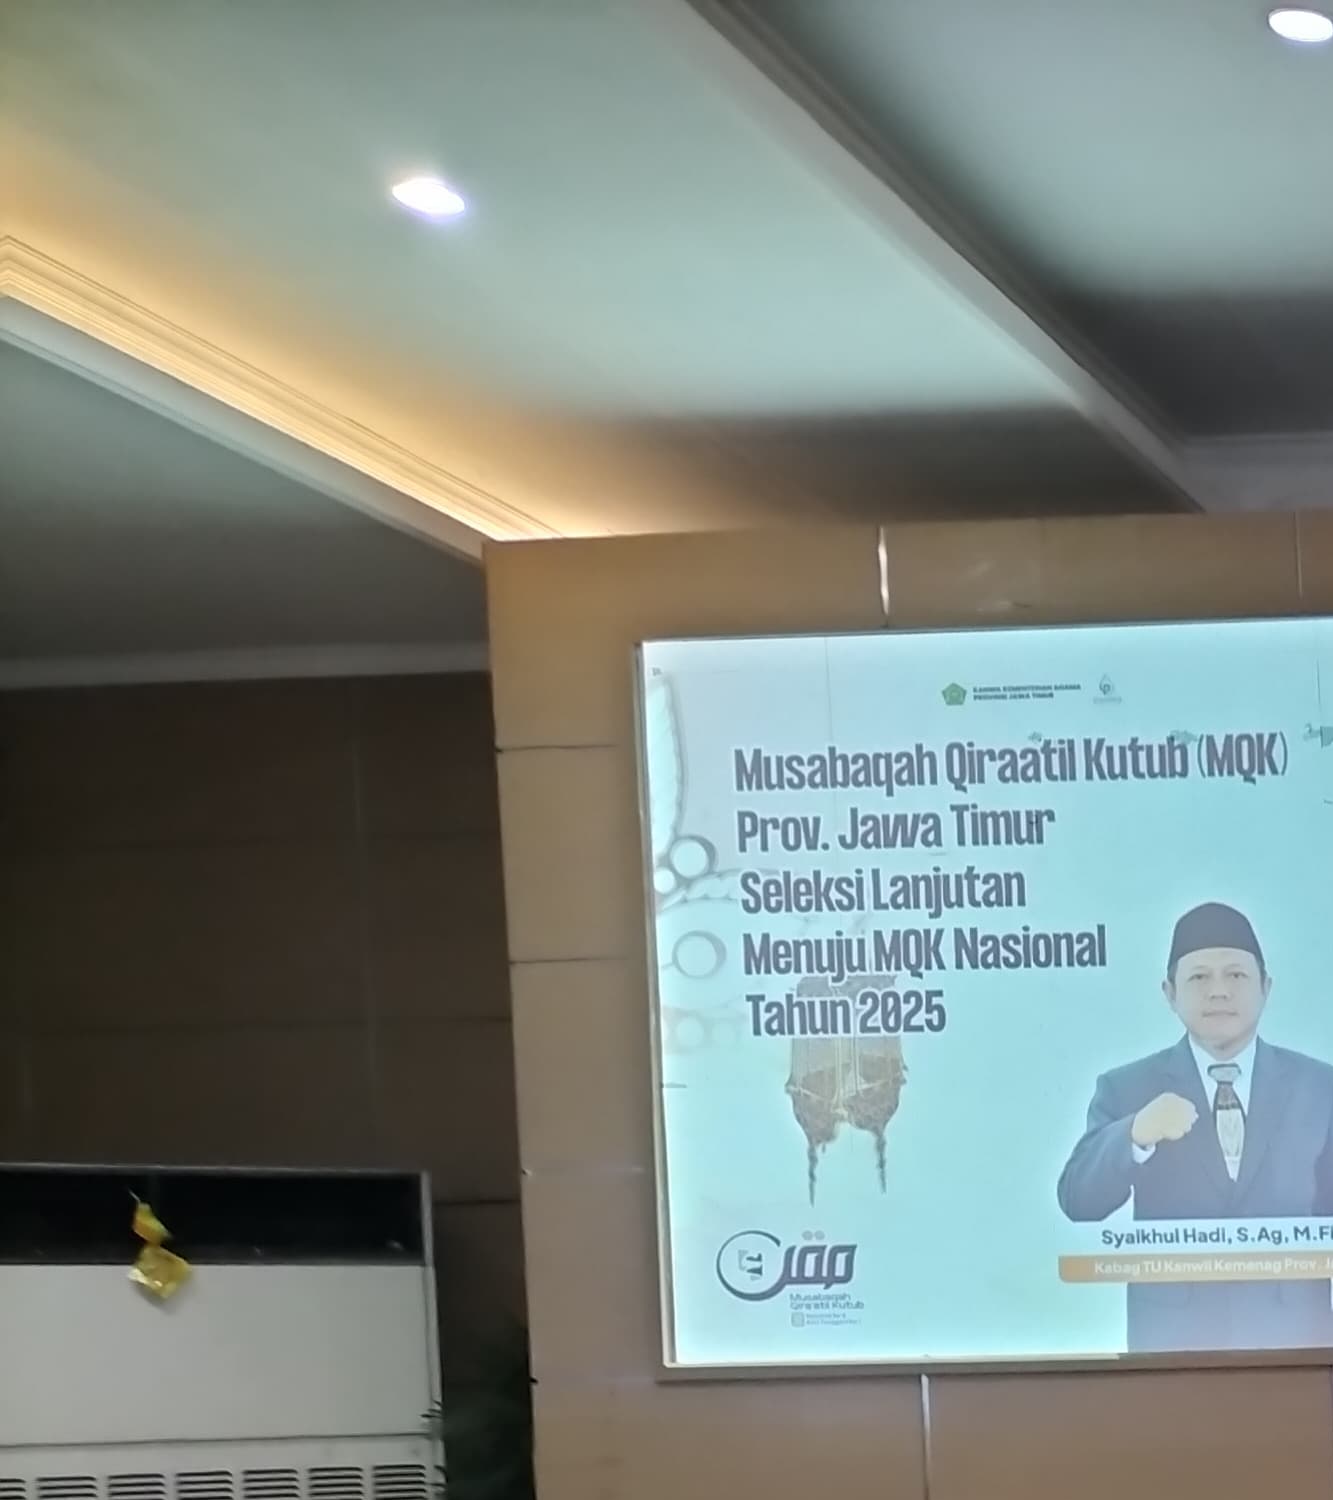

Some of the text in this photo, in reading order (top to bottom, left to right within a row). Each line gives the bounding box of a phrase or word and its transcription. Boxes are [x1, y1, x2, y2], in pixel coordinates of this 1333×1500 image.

[733, 731, 1288, 797] Musabaqah Qiraatil Kutub (MQK)
[736, 803, 1056, 853] Prov. Jawa Timur
[739, 865, 1027, 919] Seleksi Lanjutan
[742, 924, 1107, 984] Menuju MQK Nasional
[745, 989, 946, 1036] Tahun 2025
[1101, 1228, 1180, 1249] Syaikhul
[1183, 1226, 1233, 1244] Hadi,
[1236, 1226, 1289, 1245] S.Ag,
[1094, 1261, 1140, 1276] Kabag
[1143, 1260, 1161, 1273] TU
[1164, 1259, 1213, 1273] Kanwil
[1214, 1259, 1282, 1274] Kemenag
